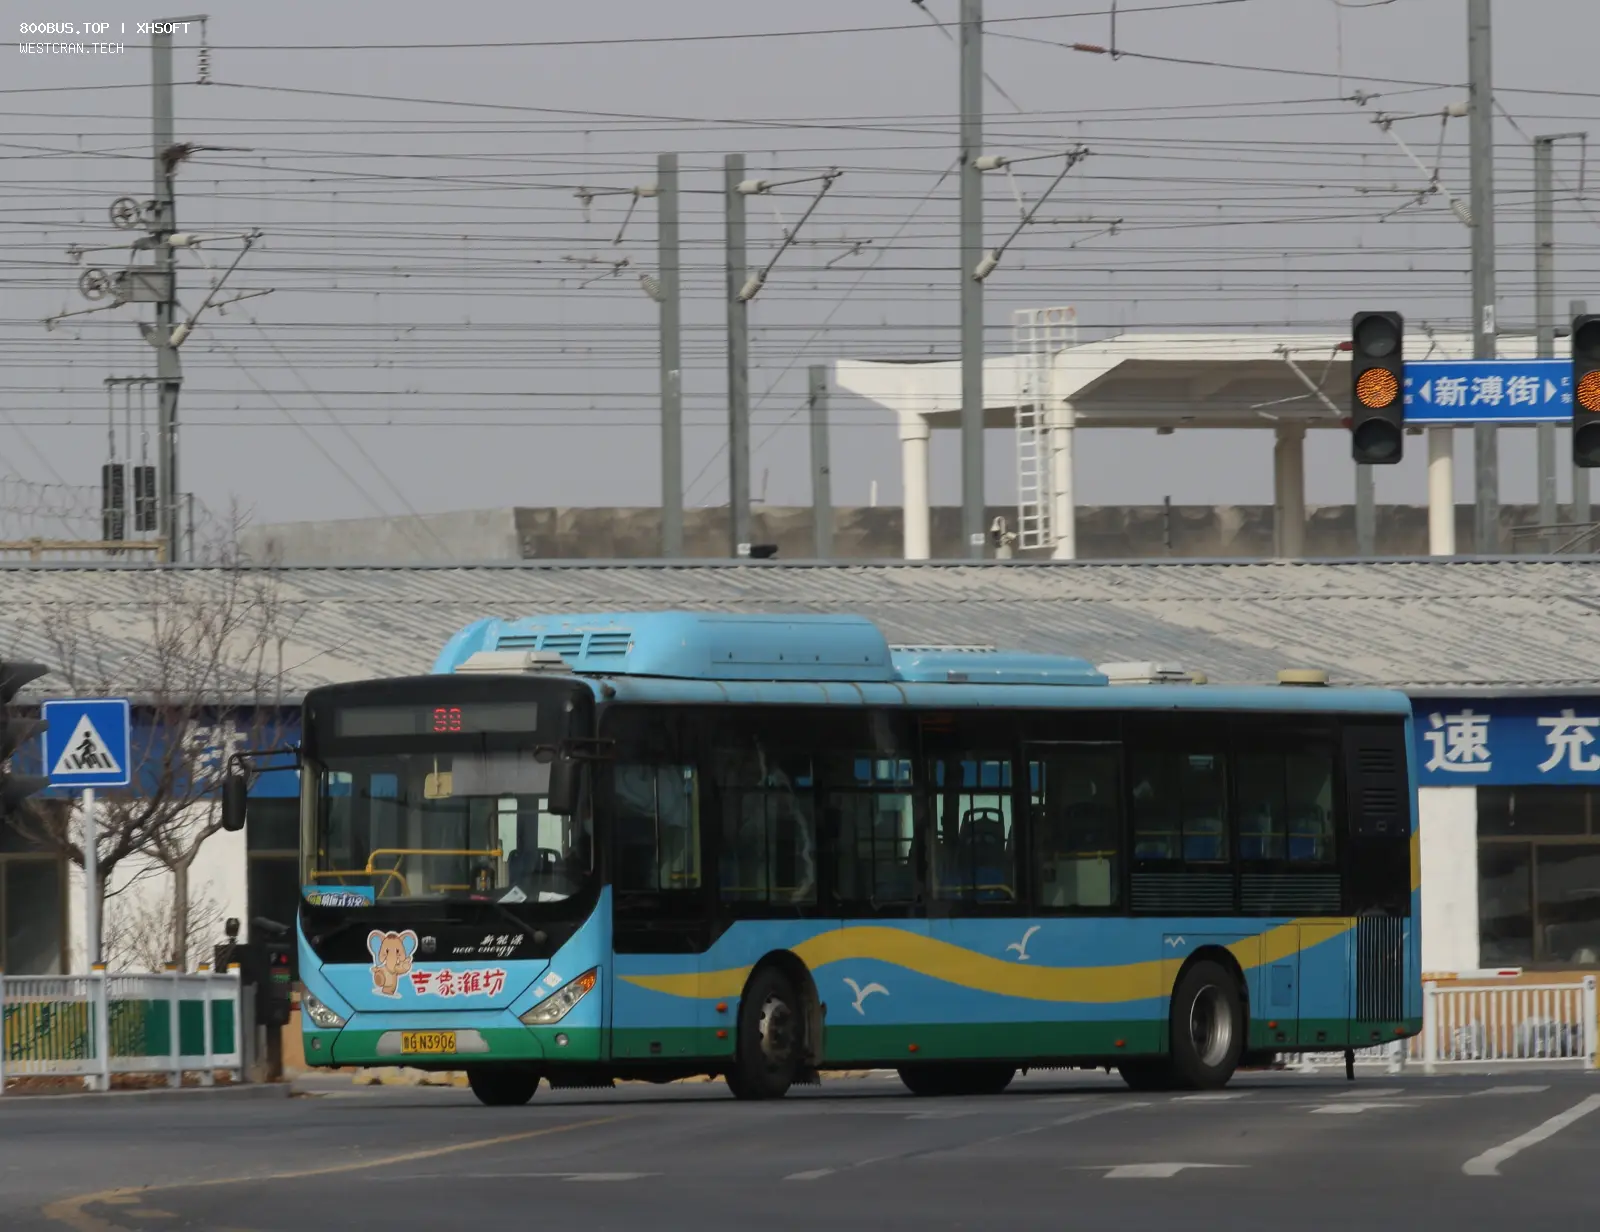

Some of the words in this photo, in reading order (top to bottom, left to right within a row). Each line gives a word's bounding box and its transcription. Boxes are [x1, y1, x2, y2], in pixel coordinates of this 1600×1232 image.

[1434, 375, 1541, 406] 新溥街
[1423, 709, 1600, 773] 速充
[478, 945, 516, 957] energy
